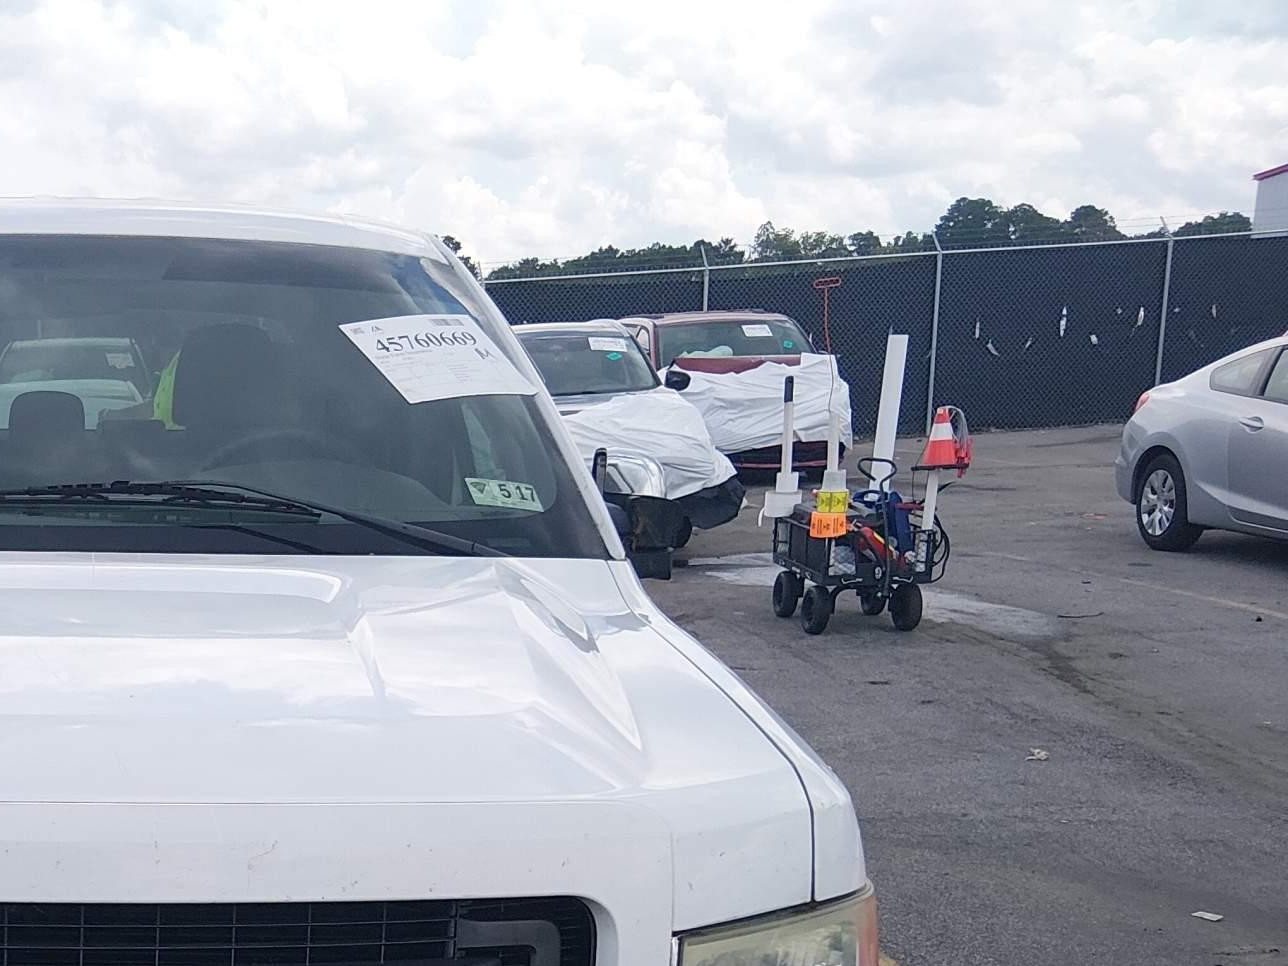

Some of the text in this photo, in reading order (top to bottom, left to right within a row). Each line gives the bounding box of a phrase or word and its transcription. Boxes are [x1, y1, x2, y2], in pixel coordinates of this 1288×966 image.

[375, 331, 477, 353] 45760669
[498, 483, 512, 499] 5
[515, 485, 536, 502] 17
